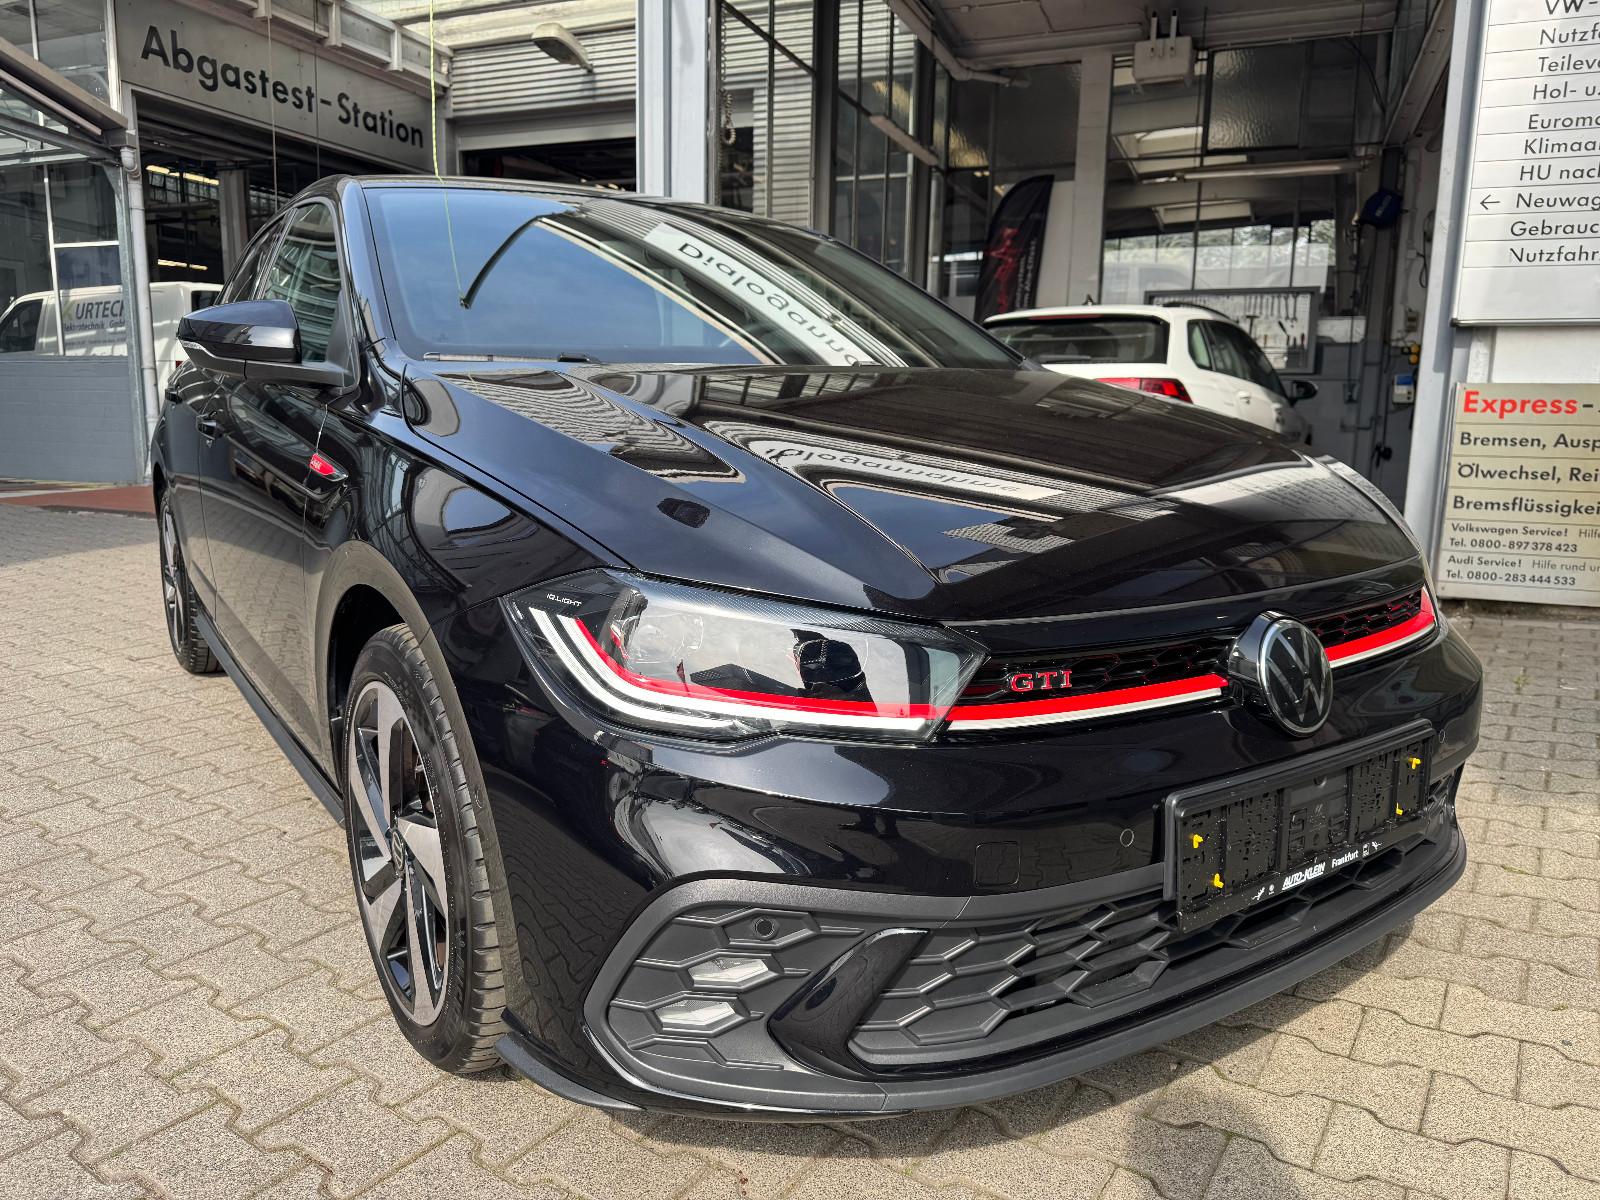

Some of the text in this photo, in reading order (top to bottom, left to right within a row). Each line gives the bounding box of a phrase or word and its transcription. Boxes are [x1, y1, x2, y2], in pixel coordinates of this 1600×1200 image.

[1539, 22, 1600, 45] Nutzf
[1538, 53, 1600, 73] Teilev
[140, 25, 423, 148] Abgastest-Station
[1533, 81, 1577, 100] Hol-
[1524, 138, 1600, 154] Klimaa
[1519, 164, 1552, 181] HU
[1510, 219, 1600, 236] Gebrauc
[1509, 245, 1600, 263] Nutzfahr
[1463, 390, 1600, 419] Express-
[1460, 431, 1600, 452] Bremsen, Ausp
[1457, 462, 1600, 484] Ölwechsel, Rei
[1453, 495, 1600, 517] Bremsflüssigkei
[1451, 522, 1519, 536] Volkswagen
[1522, 526, 1568, 537] Service!
[1449, 537, 1467, 547] Tel.
[1447, 555, 1474, 565] Audi
[1477, 557, 1522, 568] Service!
[1532, 559, 1557, 570] Hilfe
[1561, 562, 1586, 571] rund
[1446, 569, 1463, 579] Tel.
[1009, 669, 1073, 692] GTI
[1331, 849, 1359, 868] Frankfurt
